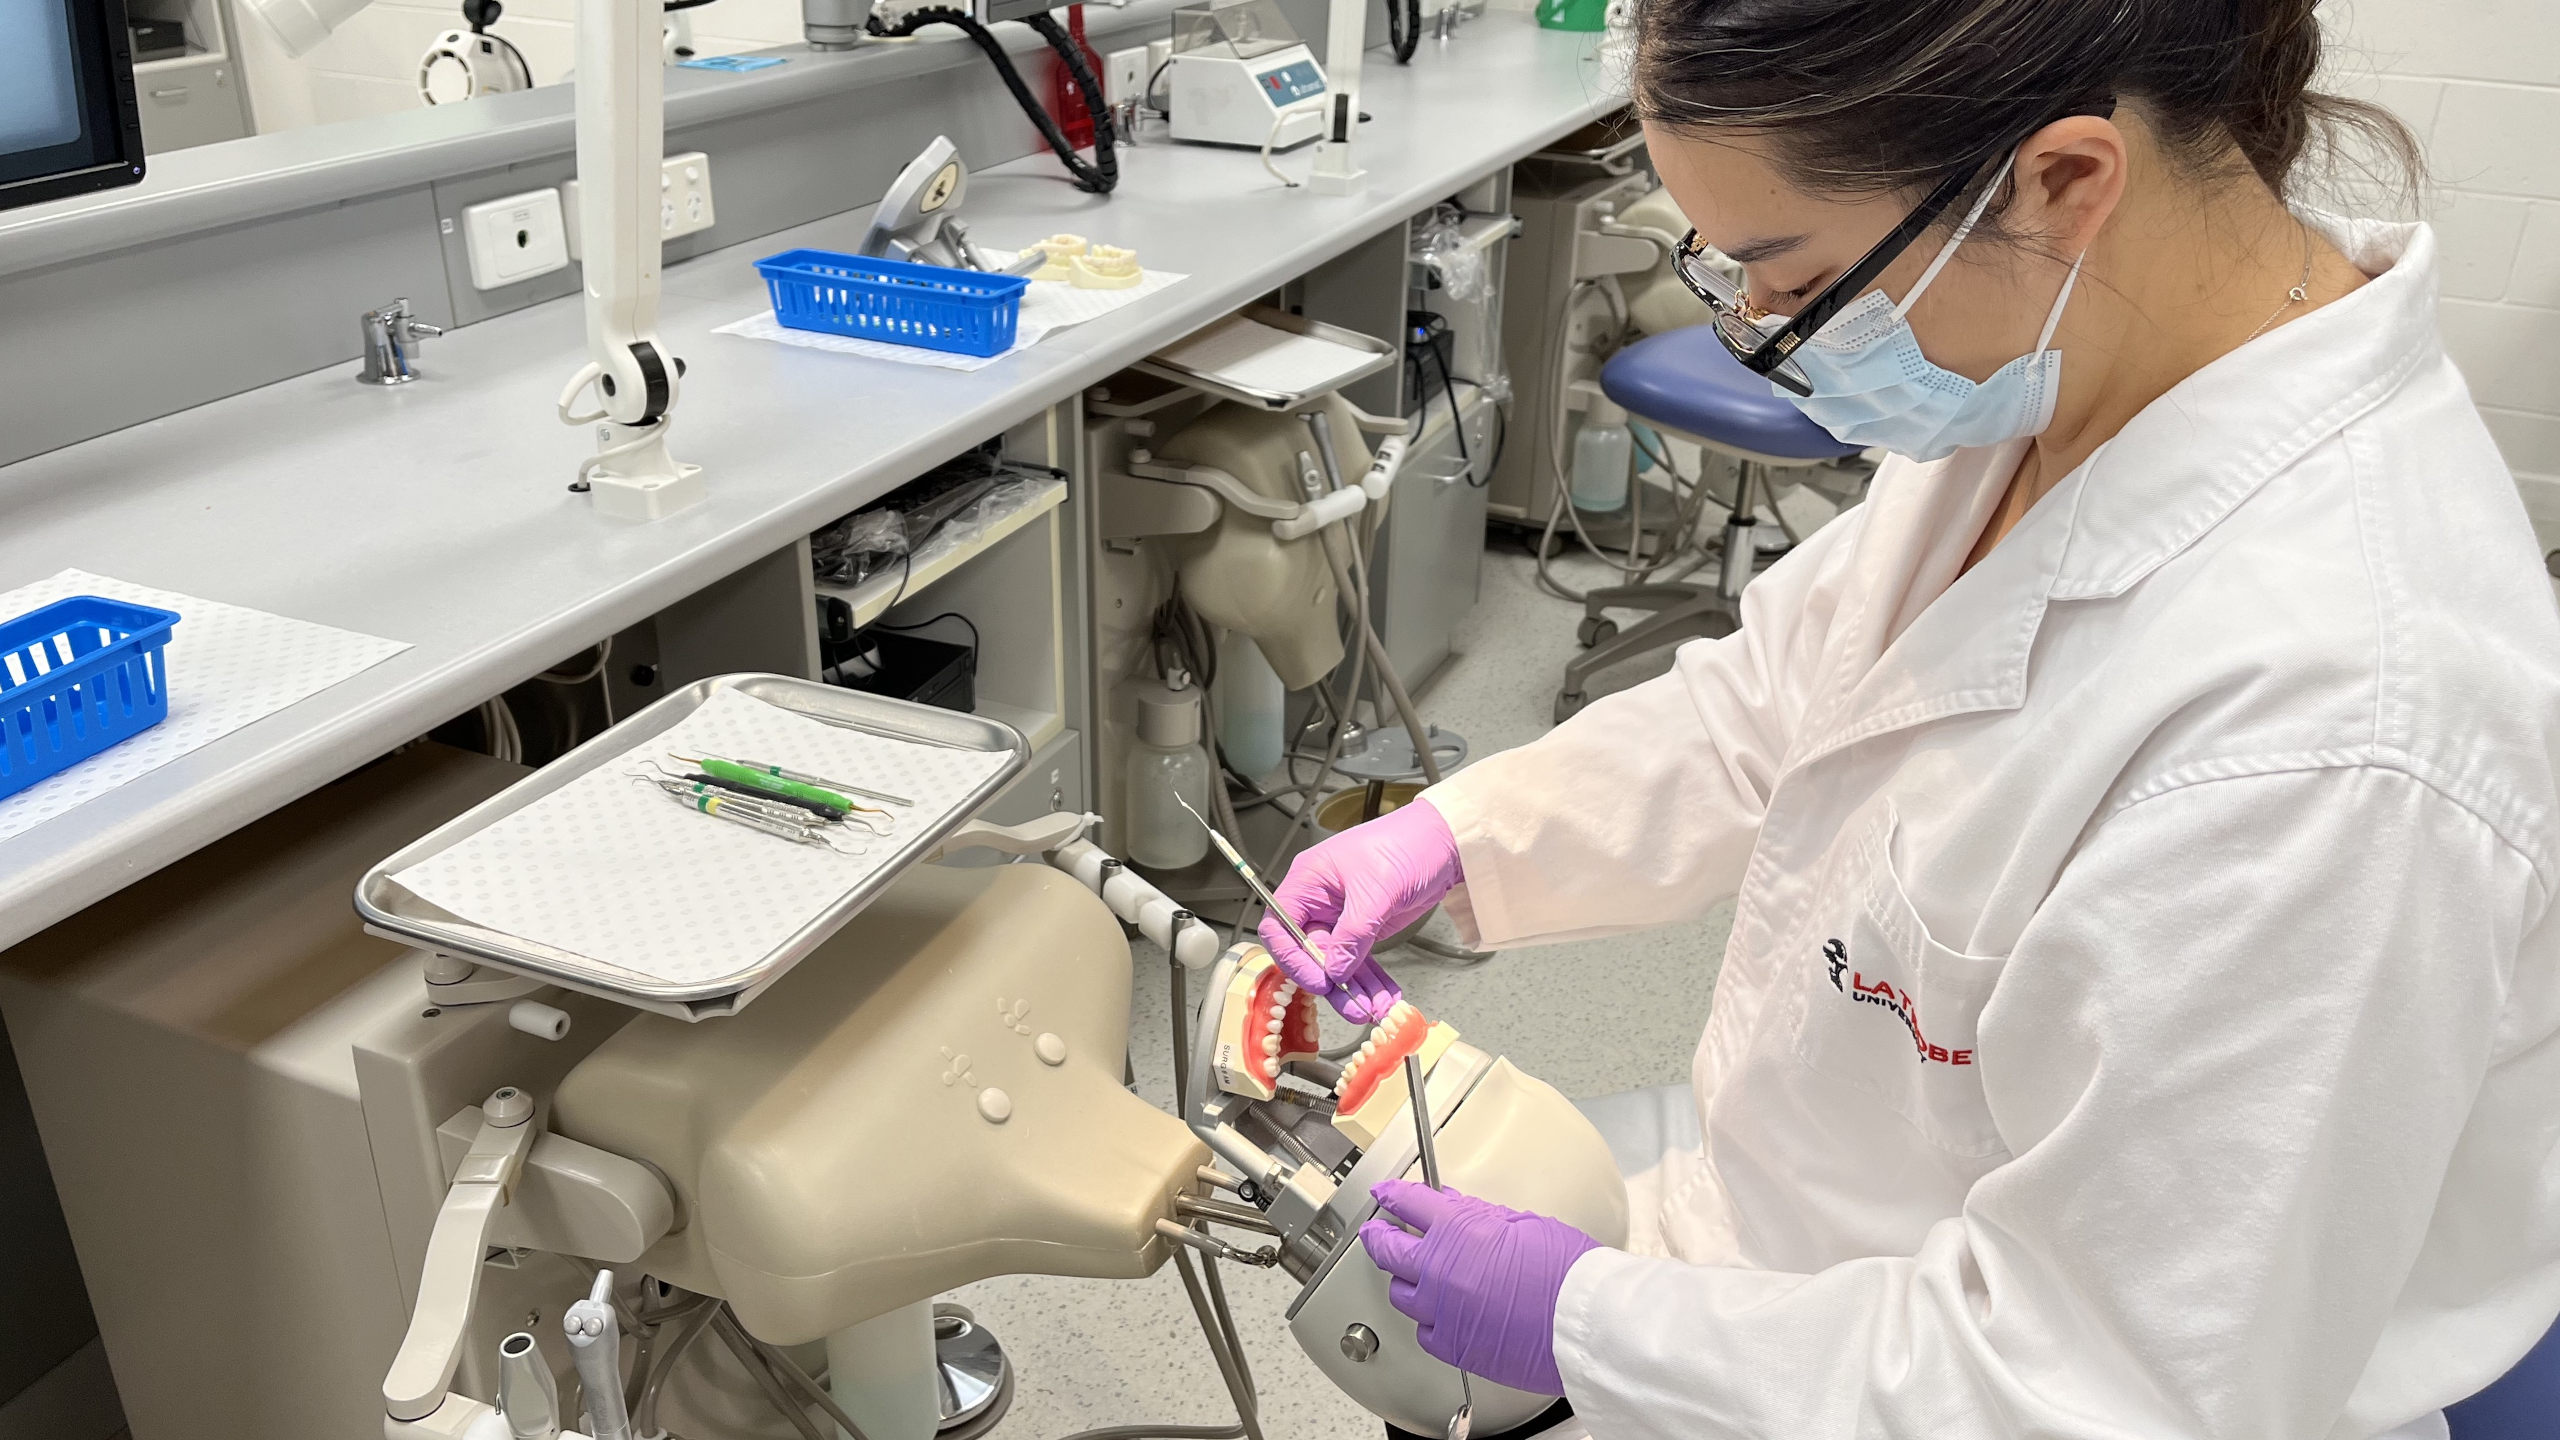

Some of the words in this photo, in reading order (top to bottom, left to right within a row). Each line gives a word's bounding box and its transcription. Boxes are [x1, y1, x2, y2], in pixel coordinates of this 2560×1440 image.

[1775, 331, 1801, 355] DIOR
[1853, 971, 1895, 999] LA
[1852, 991, 1928, 1064] UNIVERY
